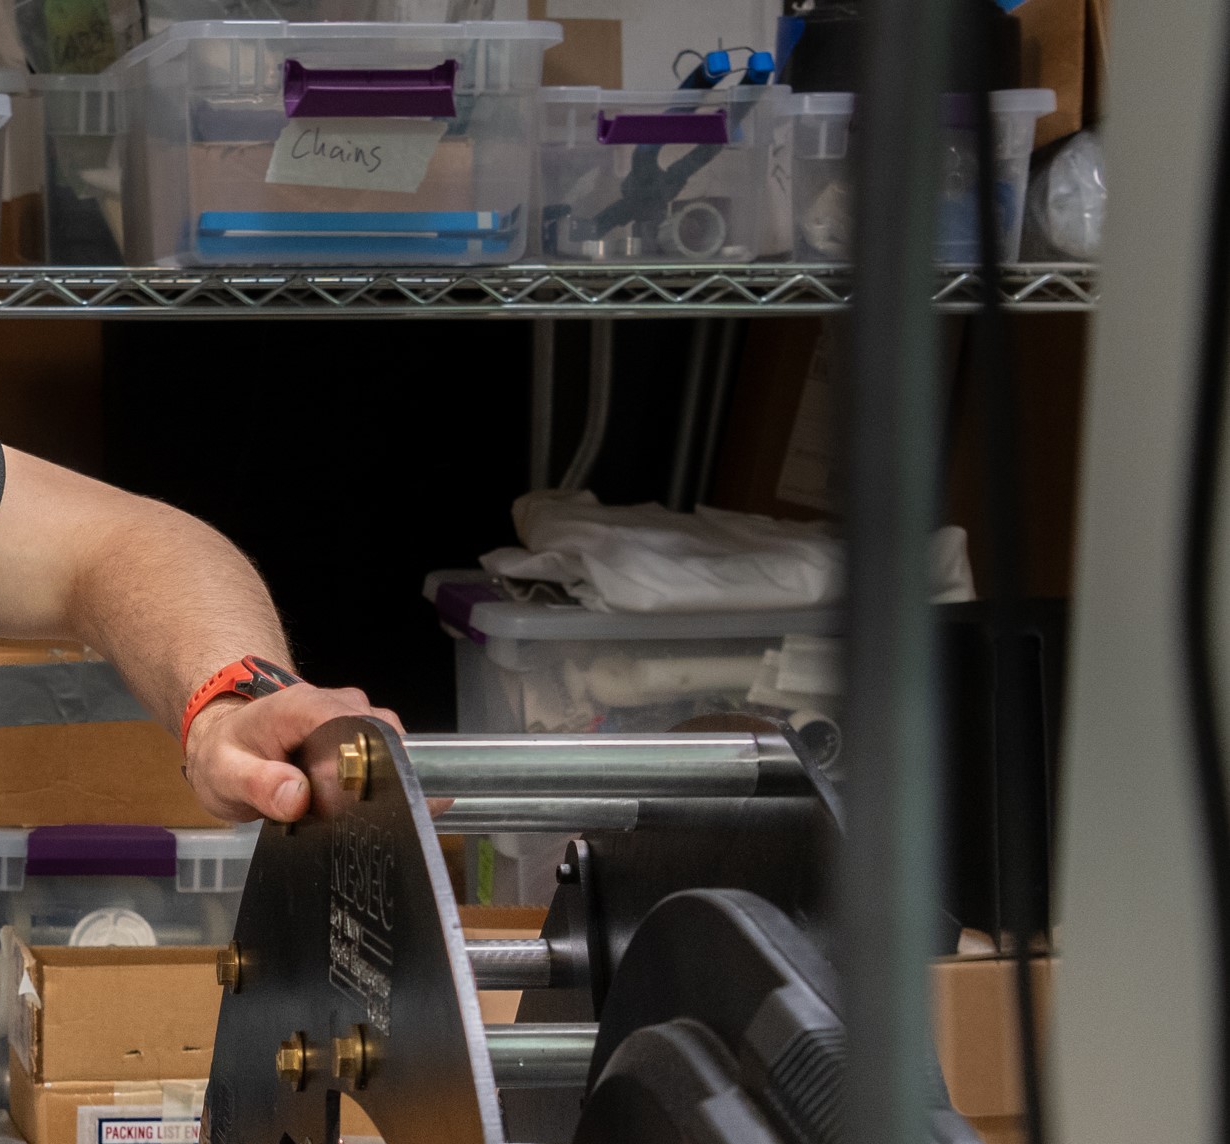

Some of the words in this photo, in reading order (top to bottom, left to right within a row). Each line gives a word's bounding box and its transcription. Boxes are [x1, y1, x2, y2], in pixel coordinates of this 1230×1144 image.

[291, 126, 382, 173] Chains
[105, 1126, 153, 1140] PACKING
[157, 1125, 180, 1139] LIST
